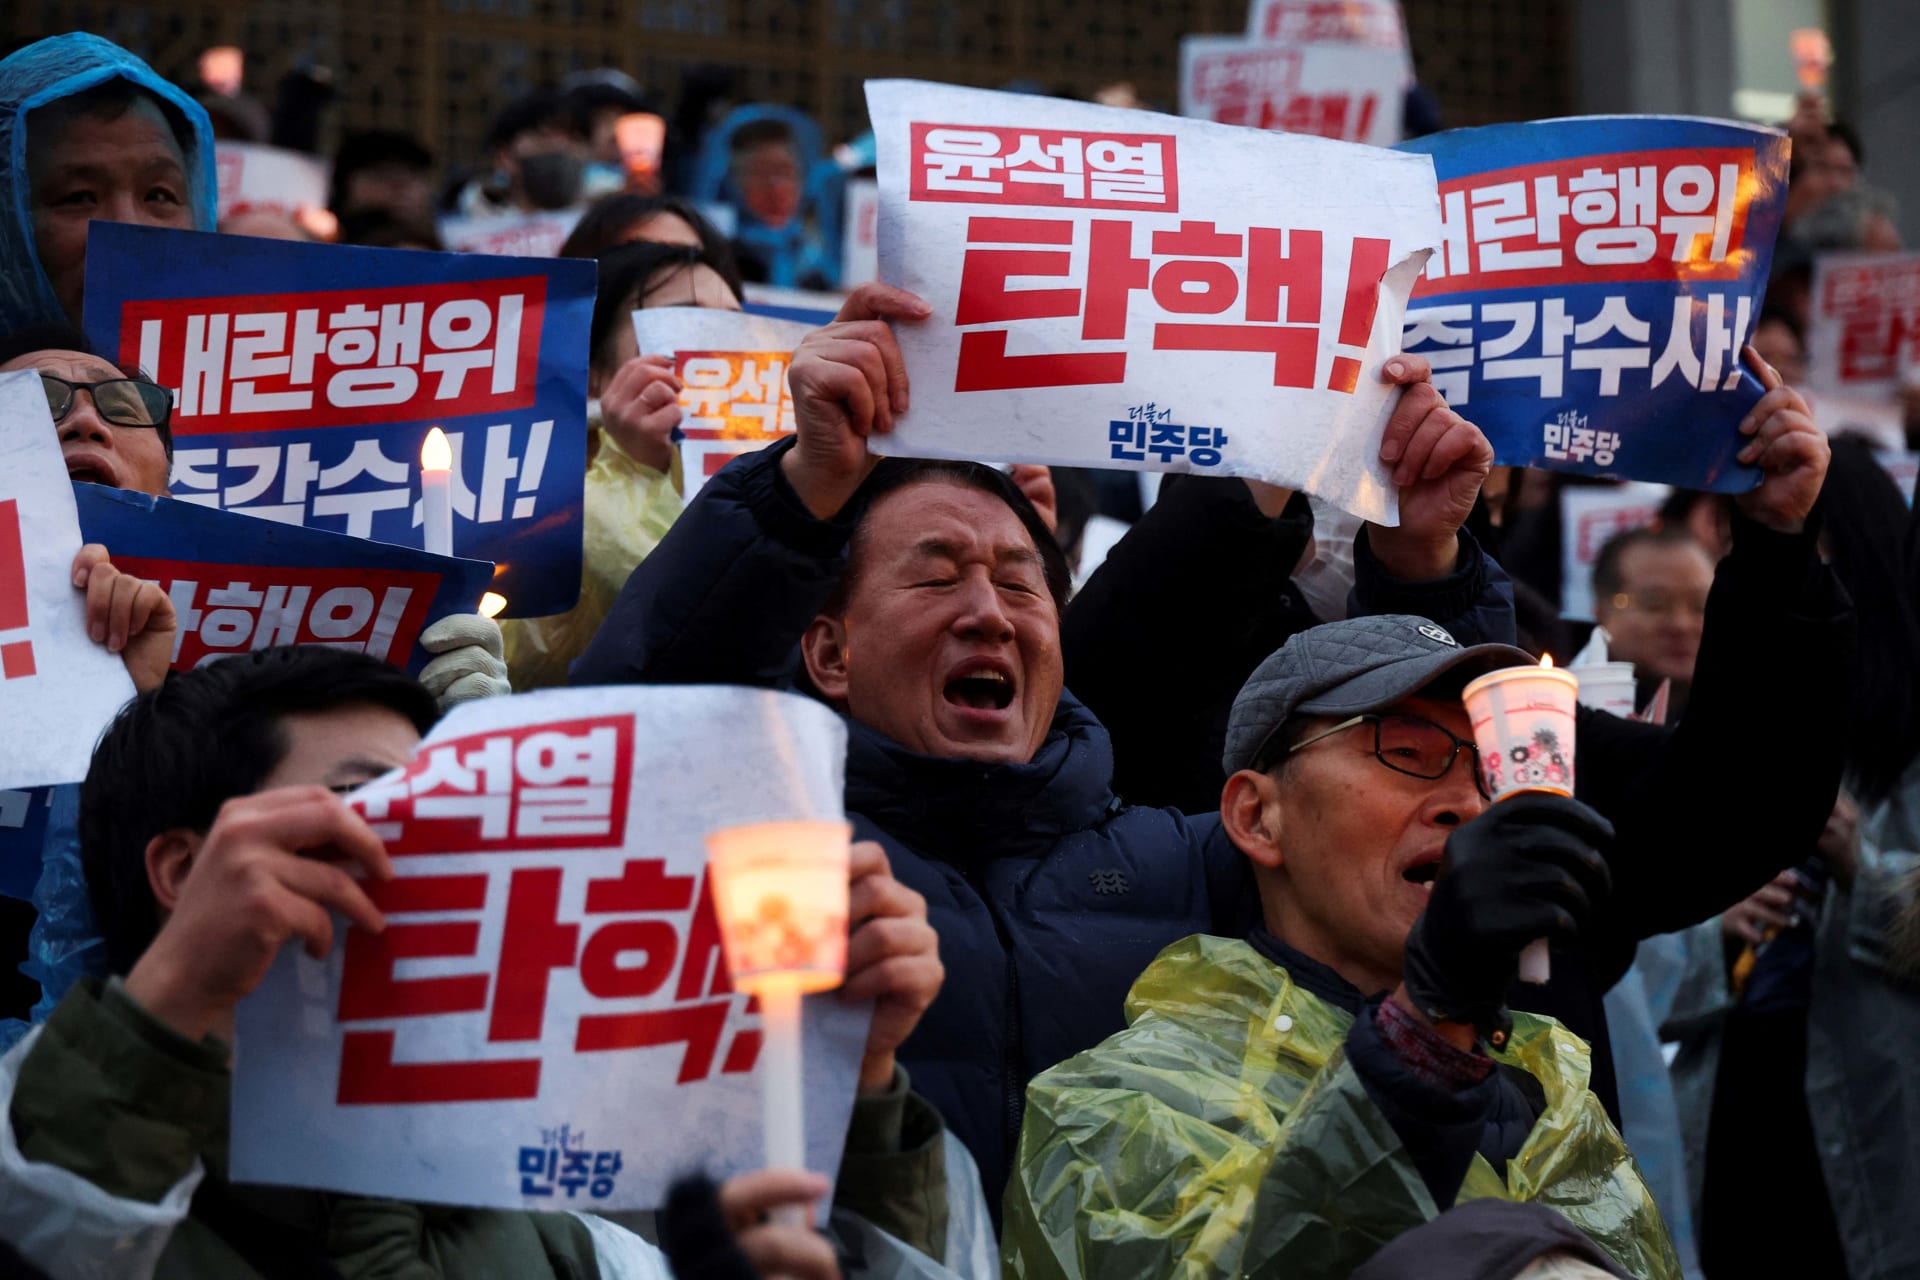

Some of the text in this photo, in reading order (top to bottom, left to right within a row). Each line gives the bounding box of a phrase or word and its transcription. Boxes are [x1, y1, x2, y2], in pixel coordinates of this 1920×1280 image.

[923, 129, 1167, 203] 윤석열
[954, 215, 1391, 394] 탄핵!
[139, 293, 525, 417] 내란행위
[1402, 293, 1751, 406] 즉각수사!
[678, 357, 798, 432] 윤석
[1128, 402, 1171, 424] 더불어
[1108, 420, 1228, 467] 민주당
[1543, 423, 1621, 466] 민주당
[518, 1146, 623, 1199] 민주당
